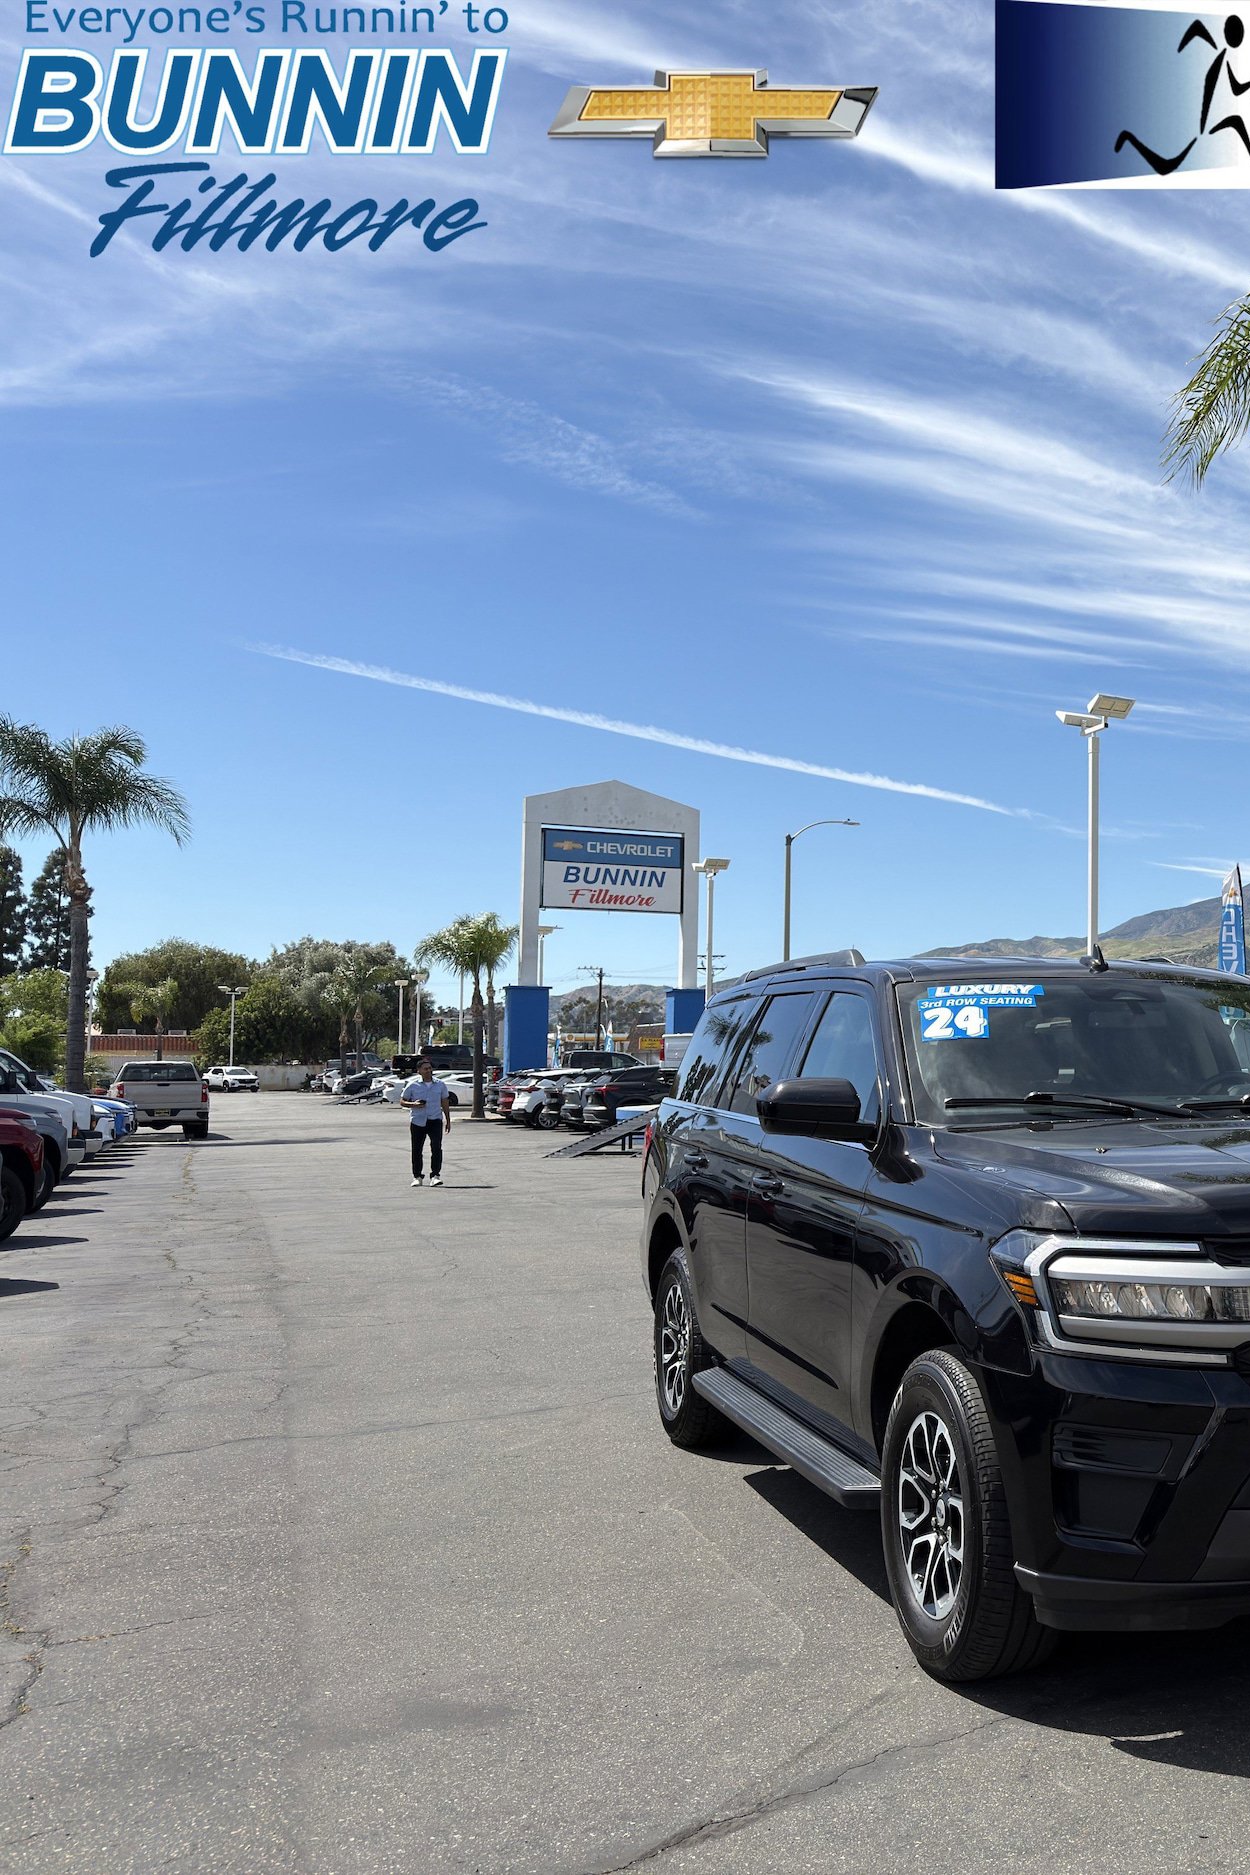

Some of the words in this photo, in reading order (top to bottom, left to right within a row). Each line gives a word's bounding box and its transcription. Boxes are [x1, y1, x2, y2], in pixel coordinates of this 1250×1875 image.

[587, 842, 674, 857] CHEVROLET
[563, 865, 667, 888] BUNNIN
[568, 888, 656, 907] Fillmore
[934, 984, 1035, 997] LUXURY
[920, 999, 941, 1009] 3rd
[946, 997, 976, 1007] ROW
[980, 996, 1033, 1006] SEATING
[923, 1005, 988, 1038] 24
